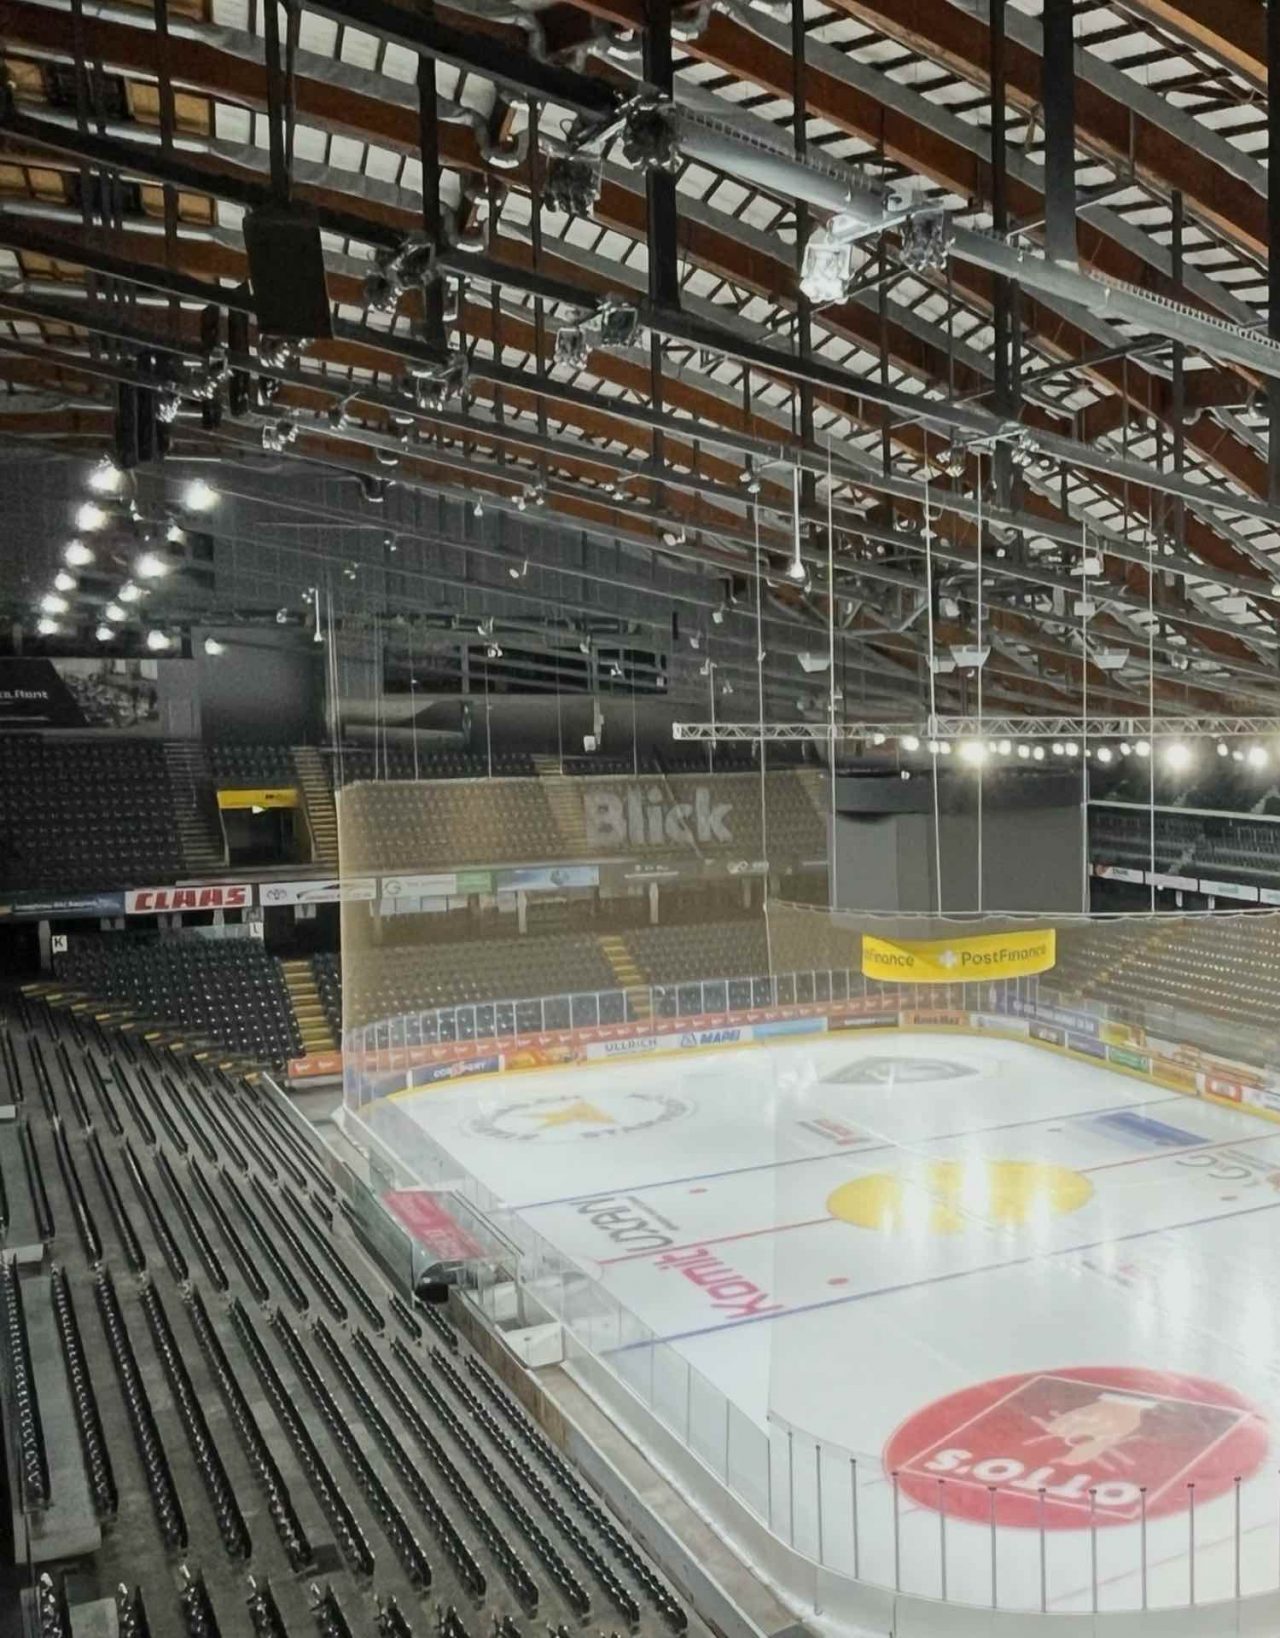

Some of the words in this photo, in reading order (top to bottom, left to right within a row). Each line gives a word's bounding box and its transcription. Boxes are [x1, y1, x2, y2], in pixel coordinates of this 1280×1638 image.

[584, 786, 733, 849] Blick
[134, 887, 246, 911] CLAAS
[54, 937, 64, 948] K
[961, 945, 1047, 966] PostFinance
[924, 1449, 1140, 1506] OTTO'S
